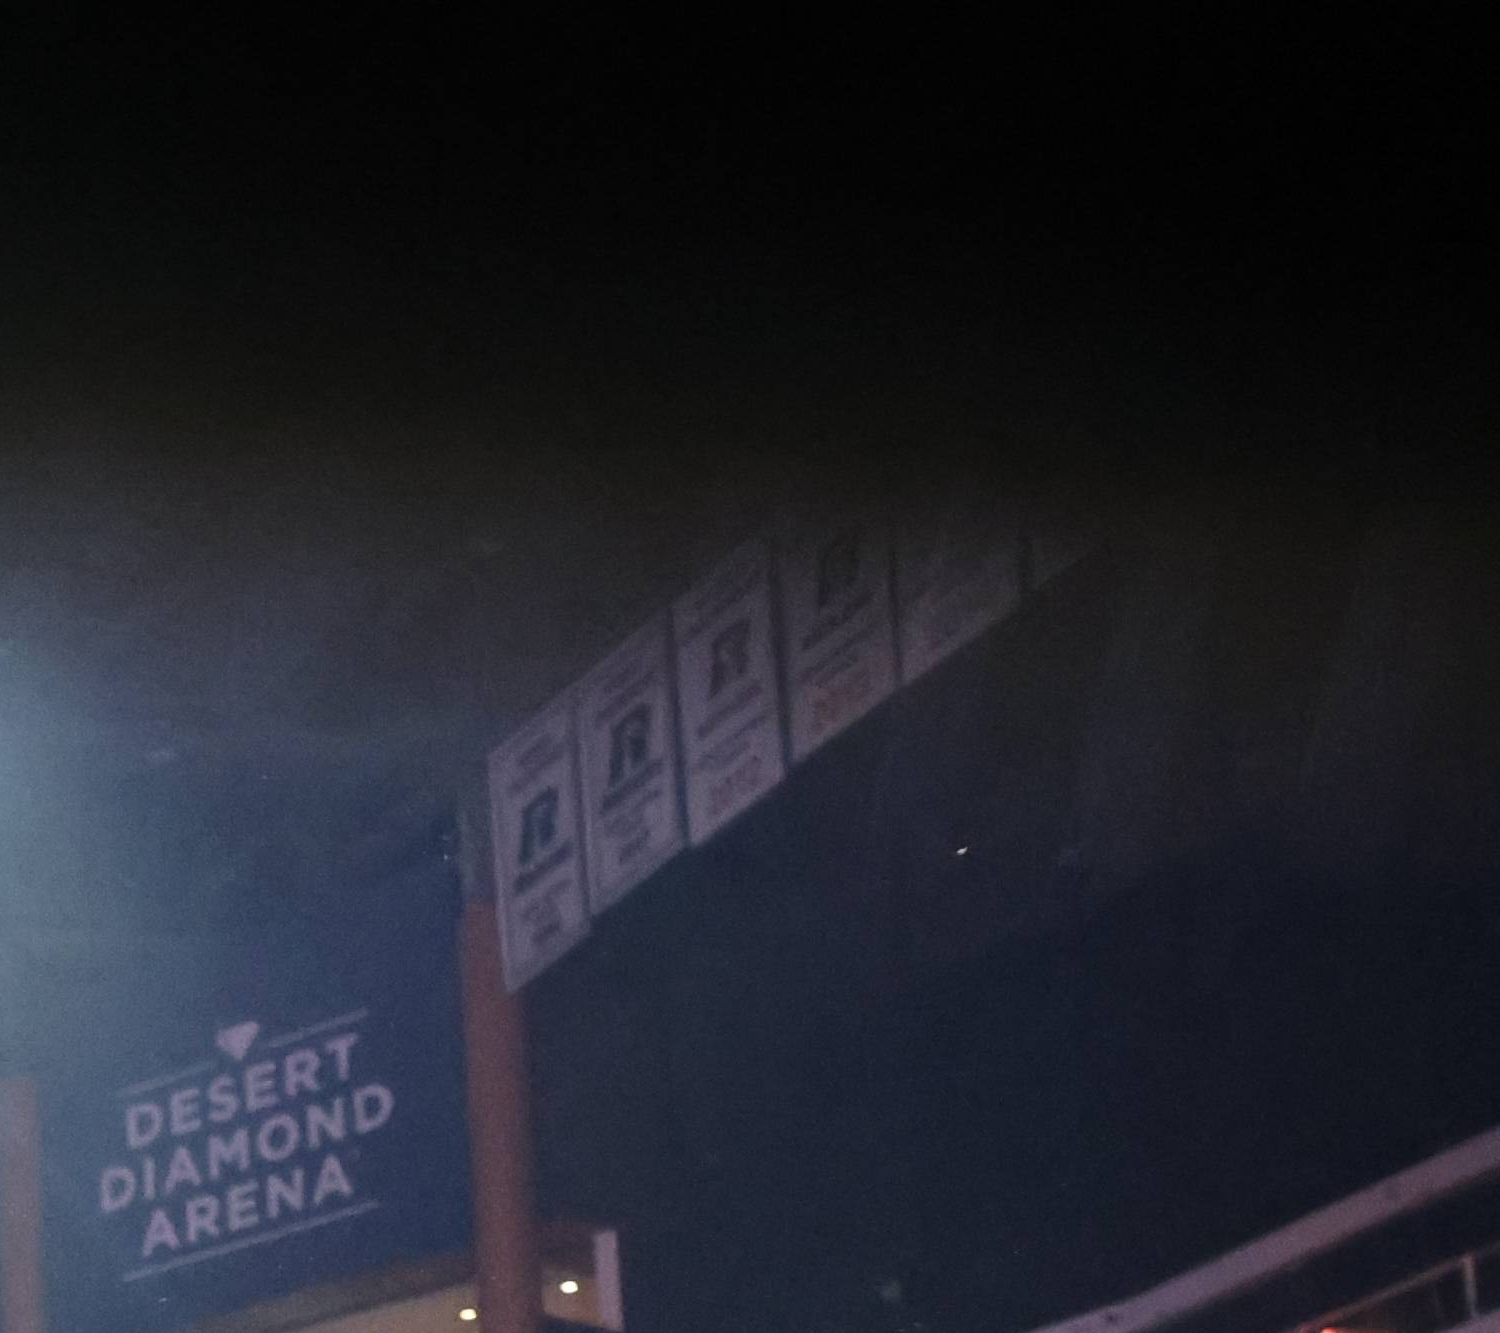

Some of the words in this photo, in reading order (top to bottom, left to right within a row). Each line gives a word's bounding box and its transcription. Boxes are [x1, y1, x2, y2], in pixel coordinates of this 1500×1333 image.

[100, 1083, 395, 1213] DIAMOND
[125, 1031, 359, 1149] DESERT
[142, 1153, 355, 1257] ARENA
